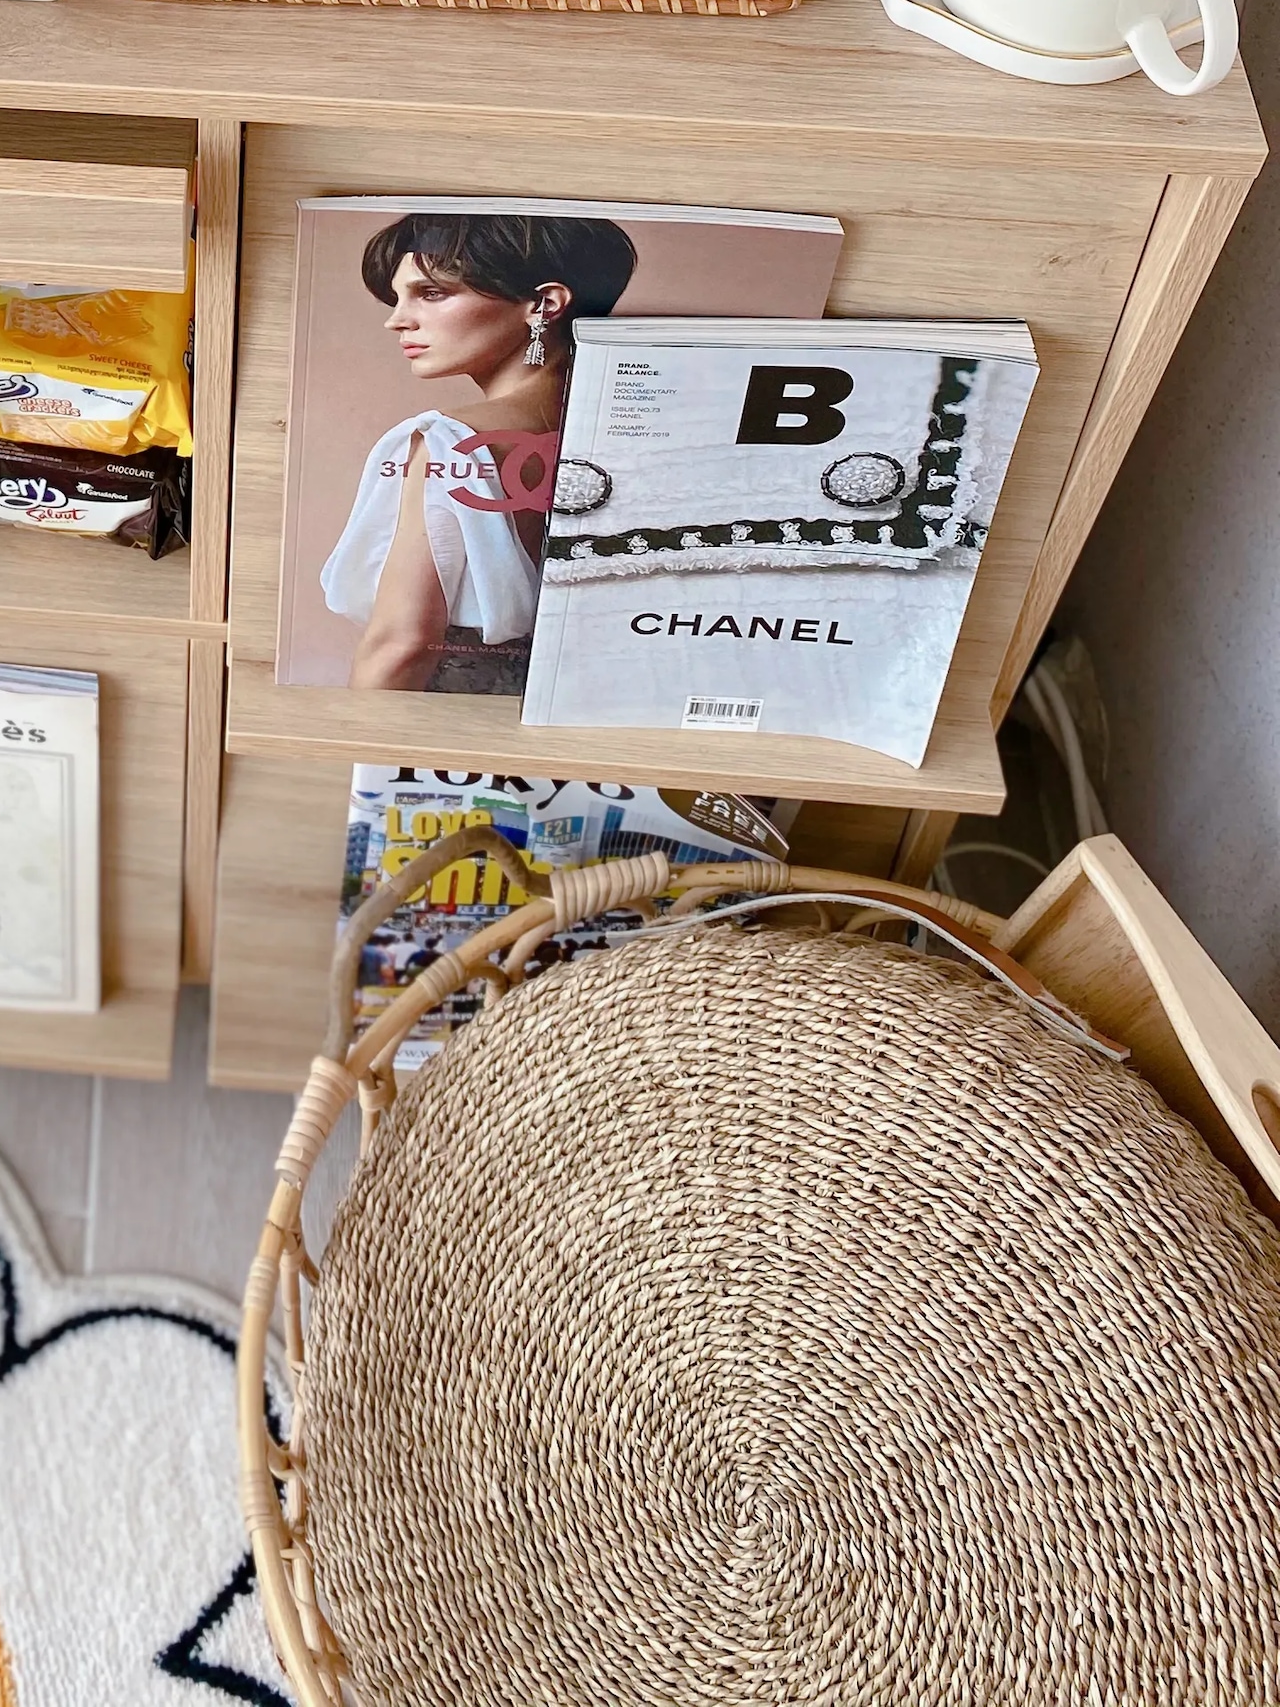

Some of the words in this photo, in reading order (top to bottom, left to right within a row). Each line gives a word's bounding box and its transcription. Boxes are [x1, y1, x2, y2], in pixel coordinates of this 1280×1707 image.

[89, 354, 117, 365] SWEET
[120, 359, 152, 371] CHEESE
[20, 405, 81, 416] crackers
[735, 365, 855, 445] B
[606, 430, 650, 438] FEBRUARY
[106, 463, 156, 479] CHOCOLATE
[380, 460, 409, 477] 31
[425, 462, 495, 479] RUE
[630, 612, 855, 647] CHANEL
[427, 644, 476, 654] CHANEL
[385, 806, 493, 842] Love
[544, 818, 573, 837] F21
